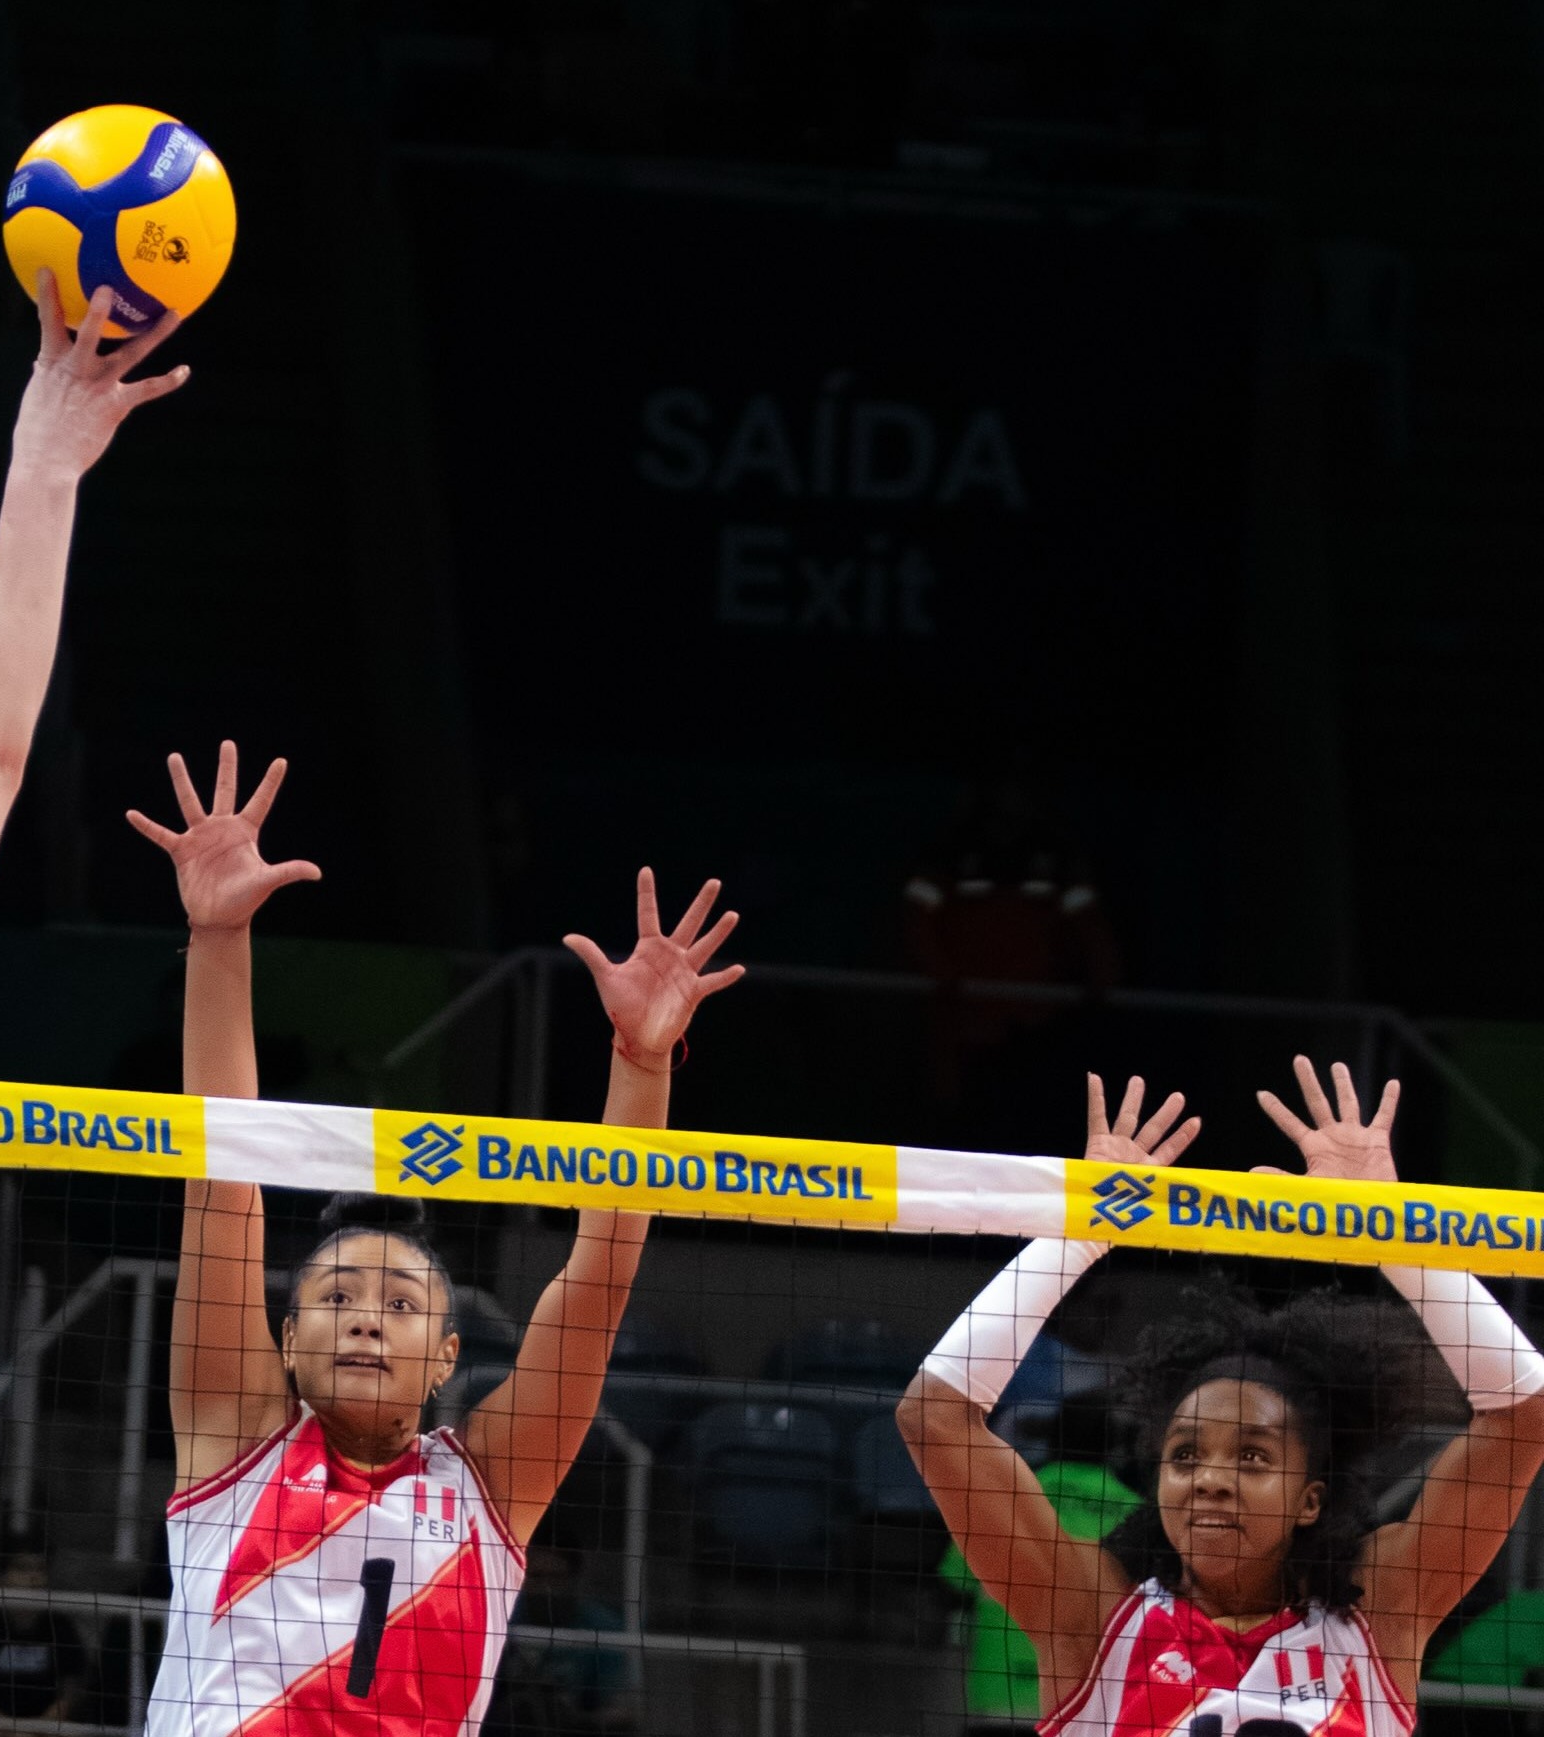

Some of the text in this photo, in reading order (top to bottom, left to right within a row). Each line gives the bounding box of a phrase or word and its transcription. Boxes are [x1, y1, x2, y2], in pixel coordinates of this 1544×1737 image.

[149, 126, 188, 179] MIKASA
[633, 366, 1030, 515] SAÍDA
[713, 522, 938, 636] Exit
[22, 1101, 182, 1155] BRASIL
[477, 1135, 873, 1200] BANCO DO BRASIL
[1168, 1184, 1326, 1236] BANCO
[1336, 1203, 1395, 1241] DO
[413, 1515, 455, 1541] PER
[346, 1557, 395, 1699] 1
[1280, 1681, 1327, 1706] PER
